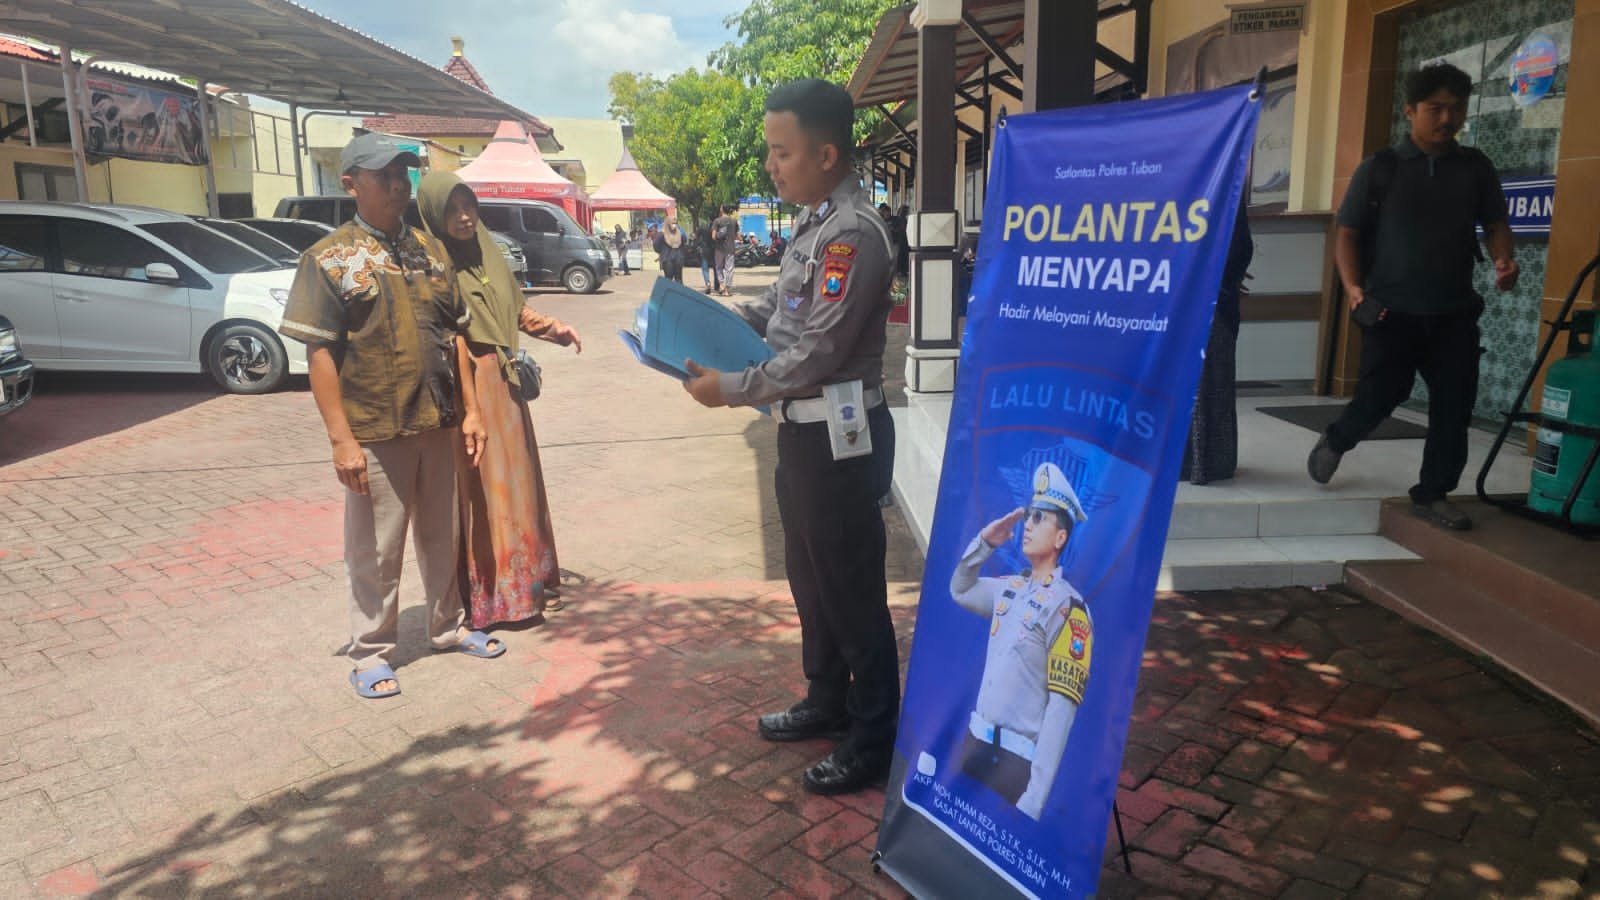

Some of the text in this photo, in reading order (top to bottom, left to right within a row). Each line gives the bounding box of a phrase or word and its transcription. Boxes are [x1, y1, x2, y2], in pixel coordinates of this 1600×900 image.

[1098, 164, 1128, 177] Polres
[1130, 162, 1162, 176] Tuban
[1003, 199, 1210, 243] POLANTAS
[1017, 256, 1170, 293] MENYAPA
[1000, 303, 1169, 335] Hadir Melayani Masyarakat
[990, 384, 1156, 440] LALU LINTAS
[913, 772, 932, 786] AKP
[954, 796, 977, 819] IMAM
[932, 796, 1047, 889] KASAT LANTAS POLRES TUBAN
